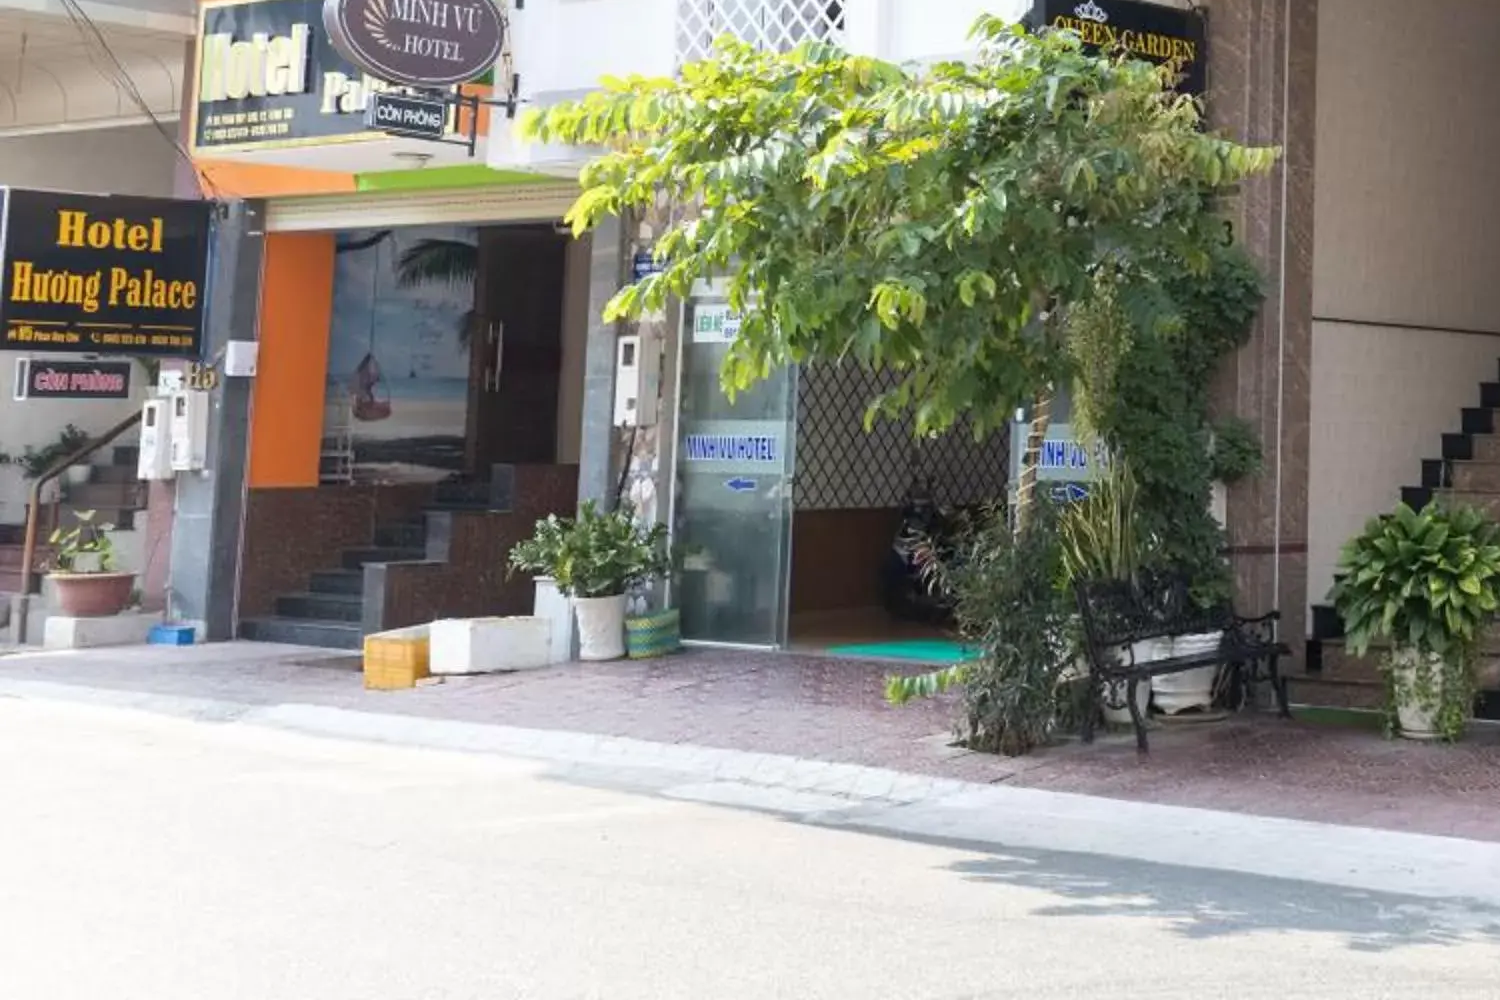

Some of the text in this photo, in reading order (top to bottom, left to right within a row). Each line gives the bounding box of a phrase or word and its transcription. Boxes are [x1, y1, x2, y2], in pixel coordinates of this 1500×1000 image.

[201, 23, 309, 103] Hotel
[404, 33, 464, 61] HOTEL
[1121, 28, 1196, 63] GARDEN
[57, 209, 163, 253] Hotel
[11, 261, 197, 313] Hương Palace
